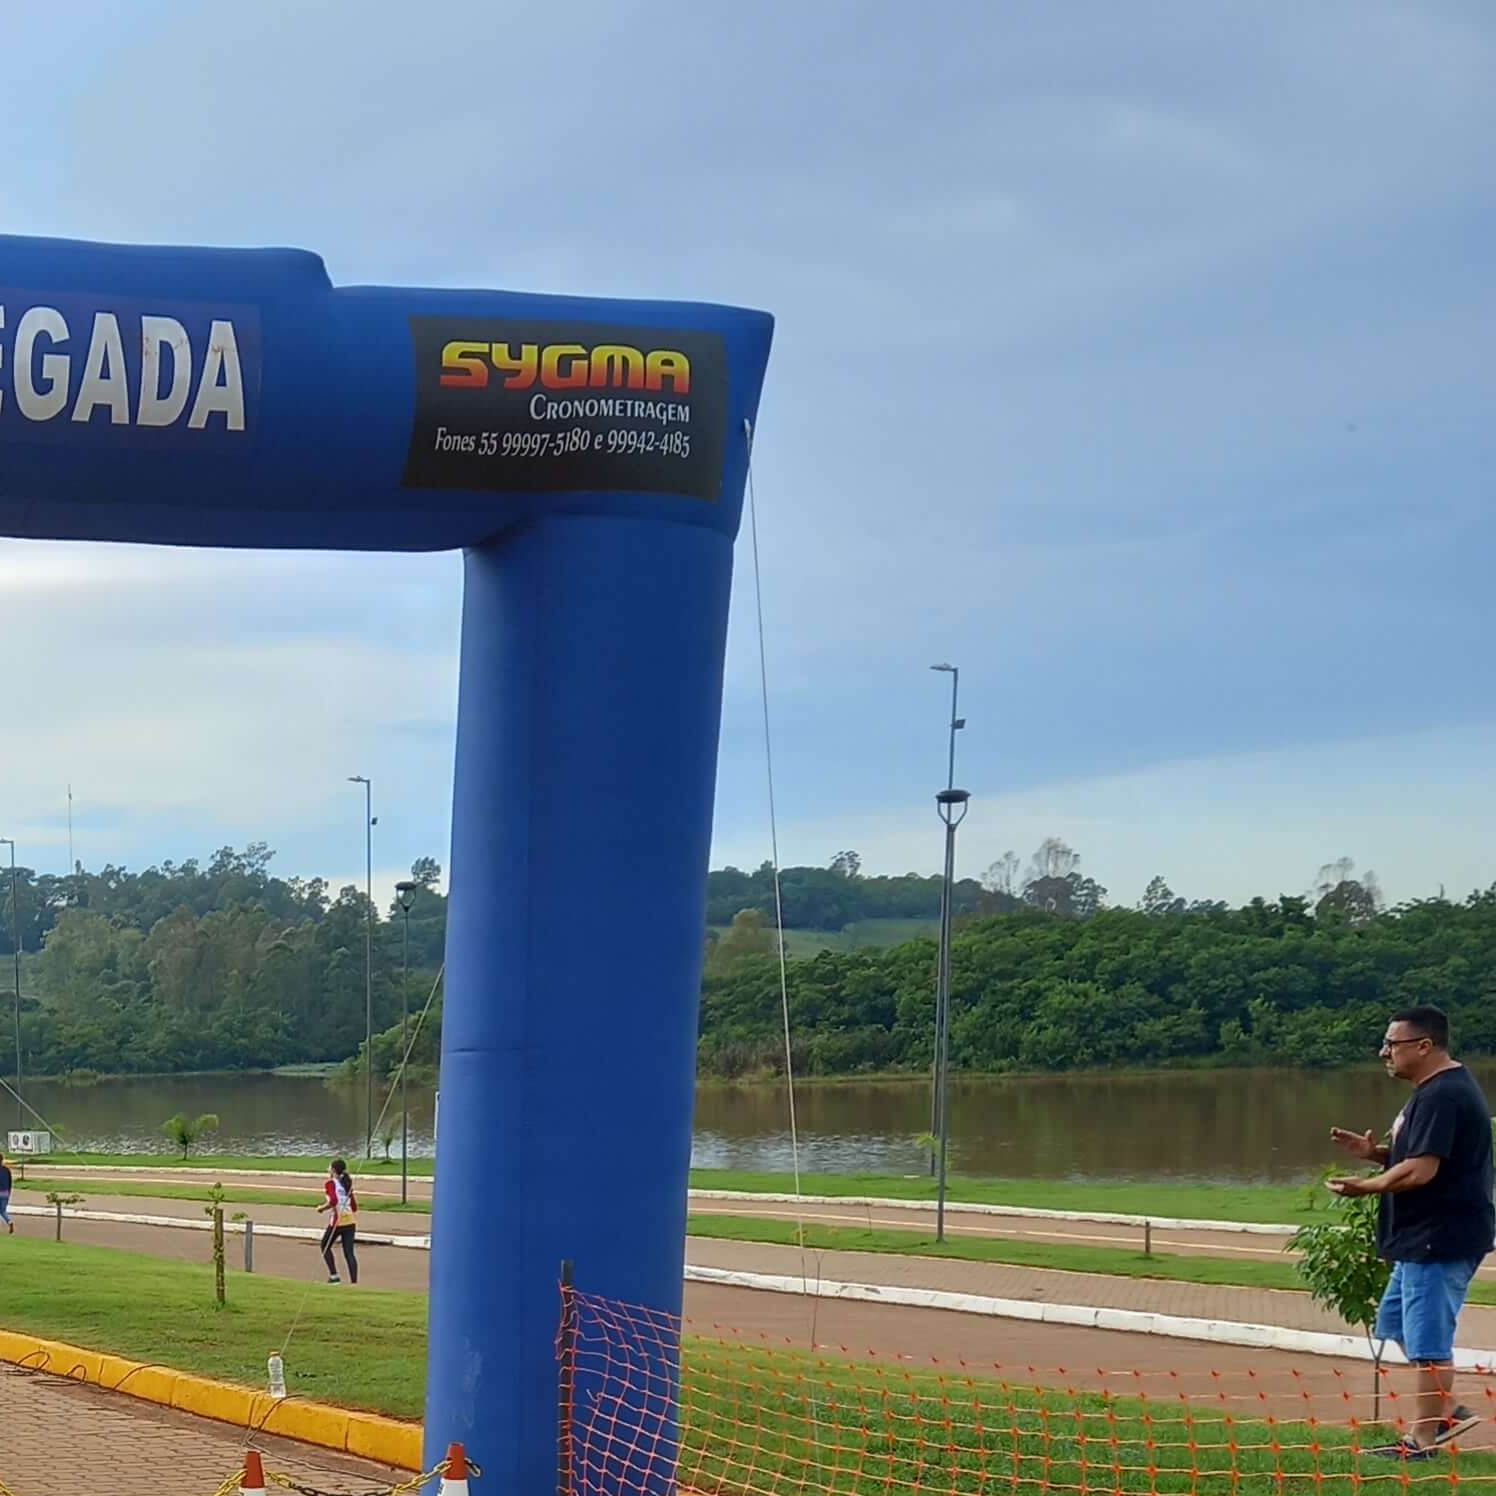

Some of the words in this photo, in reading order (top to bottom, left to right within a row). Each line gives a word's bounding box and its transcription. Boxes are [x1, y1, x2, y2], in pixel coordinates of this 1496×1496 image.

[439, 341, 690, 394] SYGMA
[530, 394, 690, 425] CRONOMETRAGEM
[435, 427, 476, 451] Fones
[478, 432, 498, 456] 55
[502, 427, 590, 457] 99997-5180
[594, 434, 603, 449] e
[607, 429, 690, 458] 99942-4185
